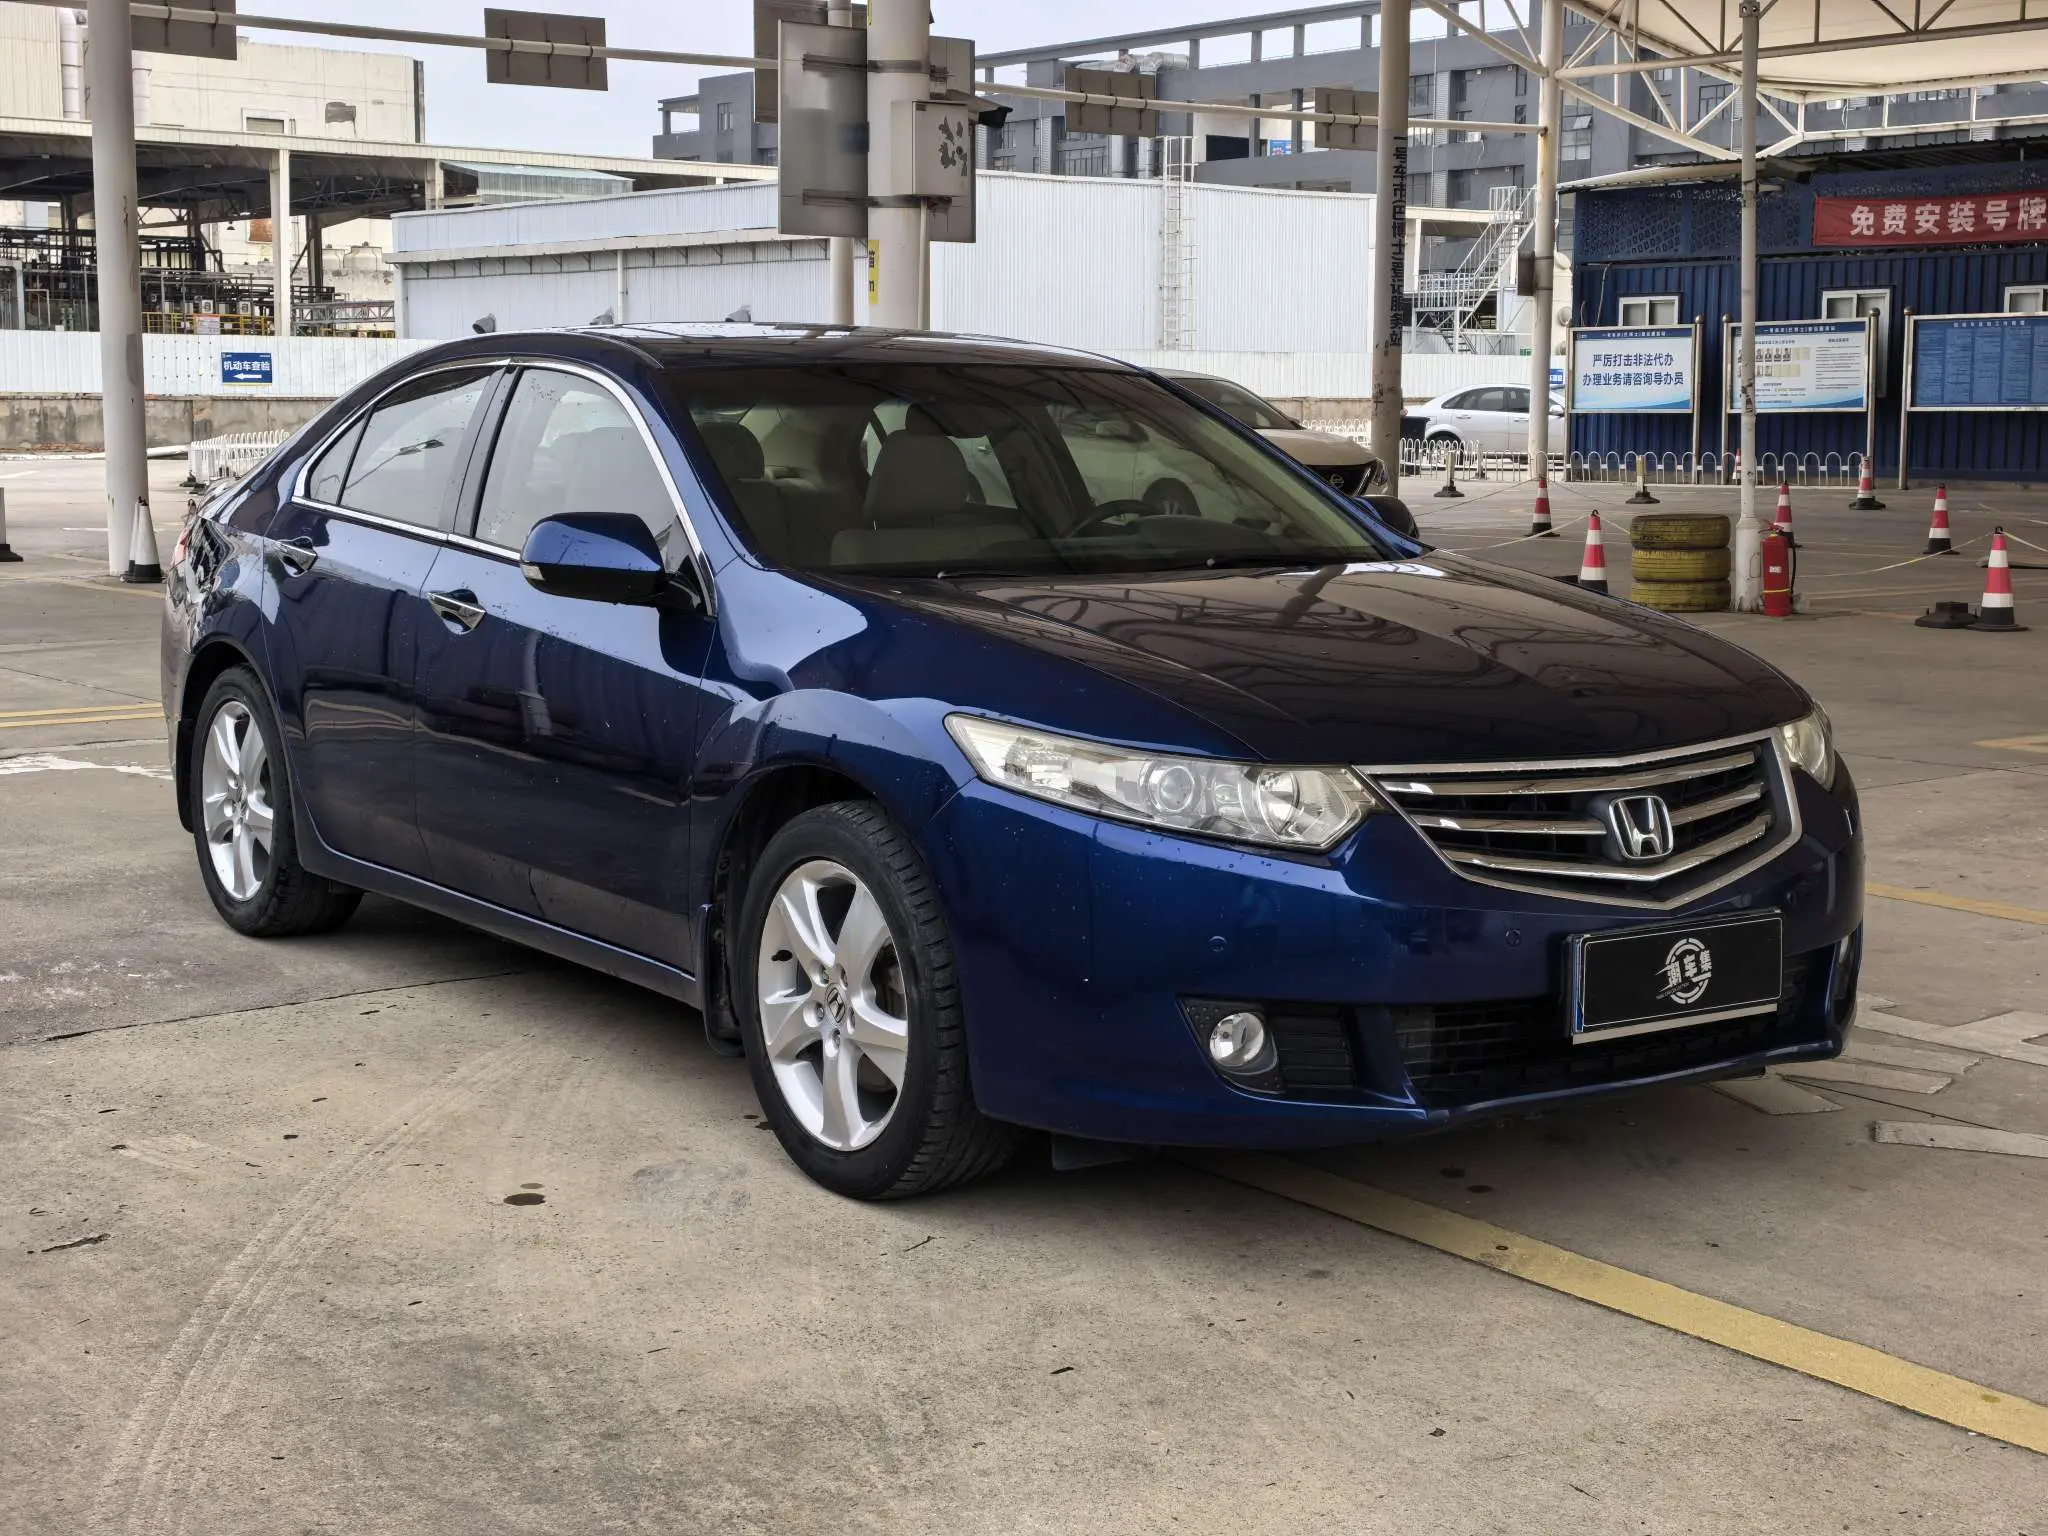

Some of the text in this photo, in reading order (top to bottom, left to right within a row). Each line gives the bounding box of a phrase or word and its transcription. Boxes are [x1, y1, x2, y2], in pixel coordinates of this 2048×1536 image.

[1849, 196, 2047, 236] 免费安装号牌
[1592, 352, 1675, 367] 严厉打击非法代办
[1582, 371, 1684, 386] 办理业务请咨询导办员
